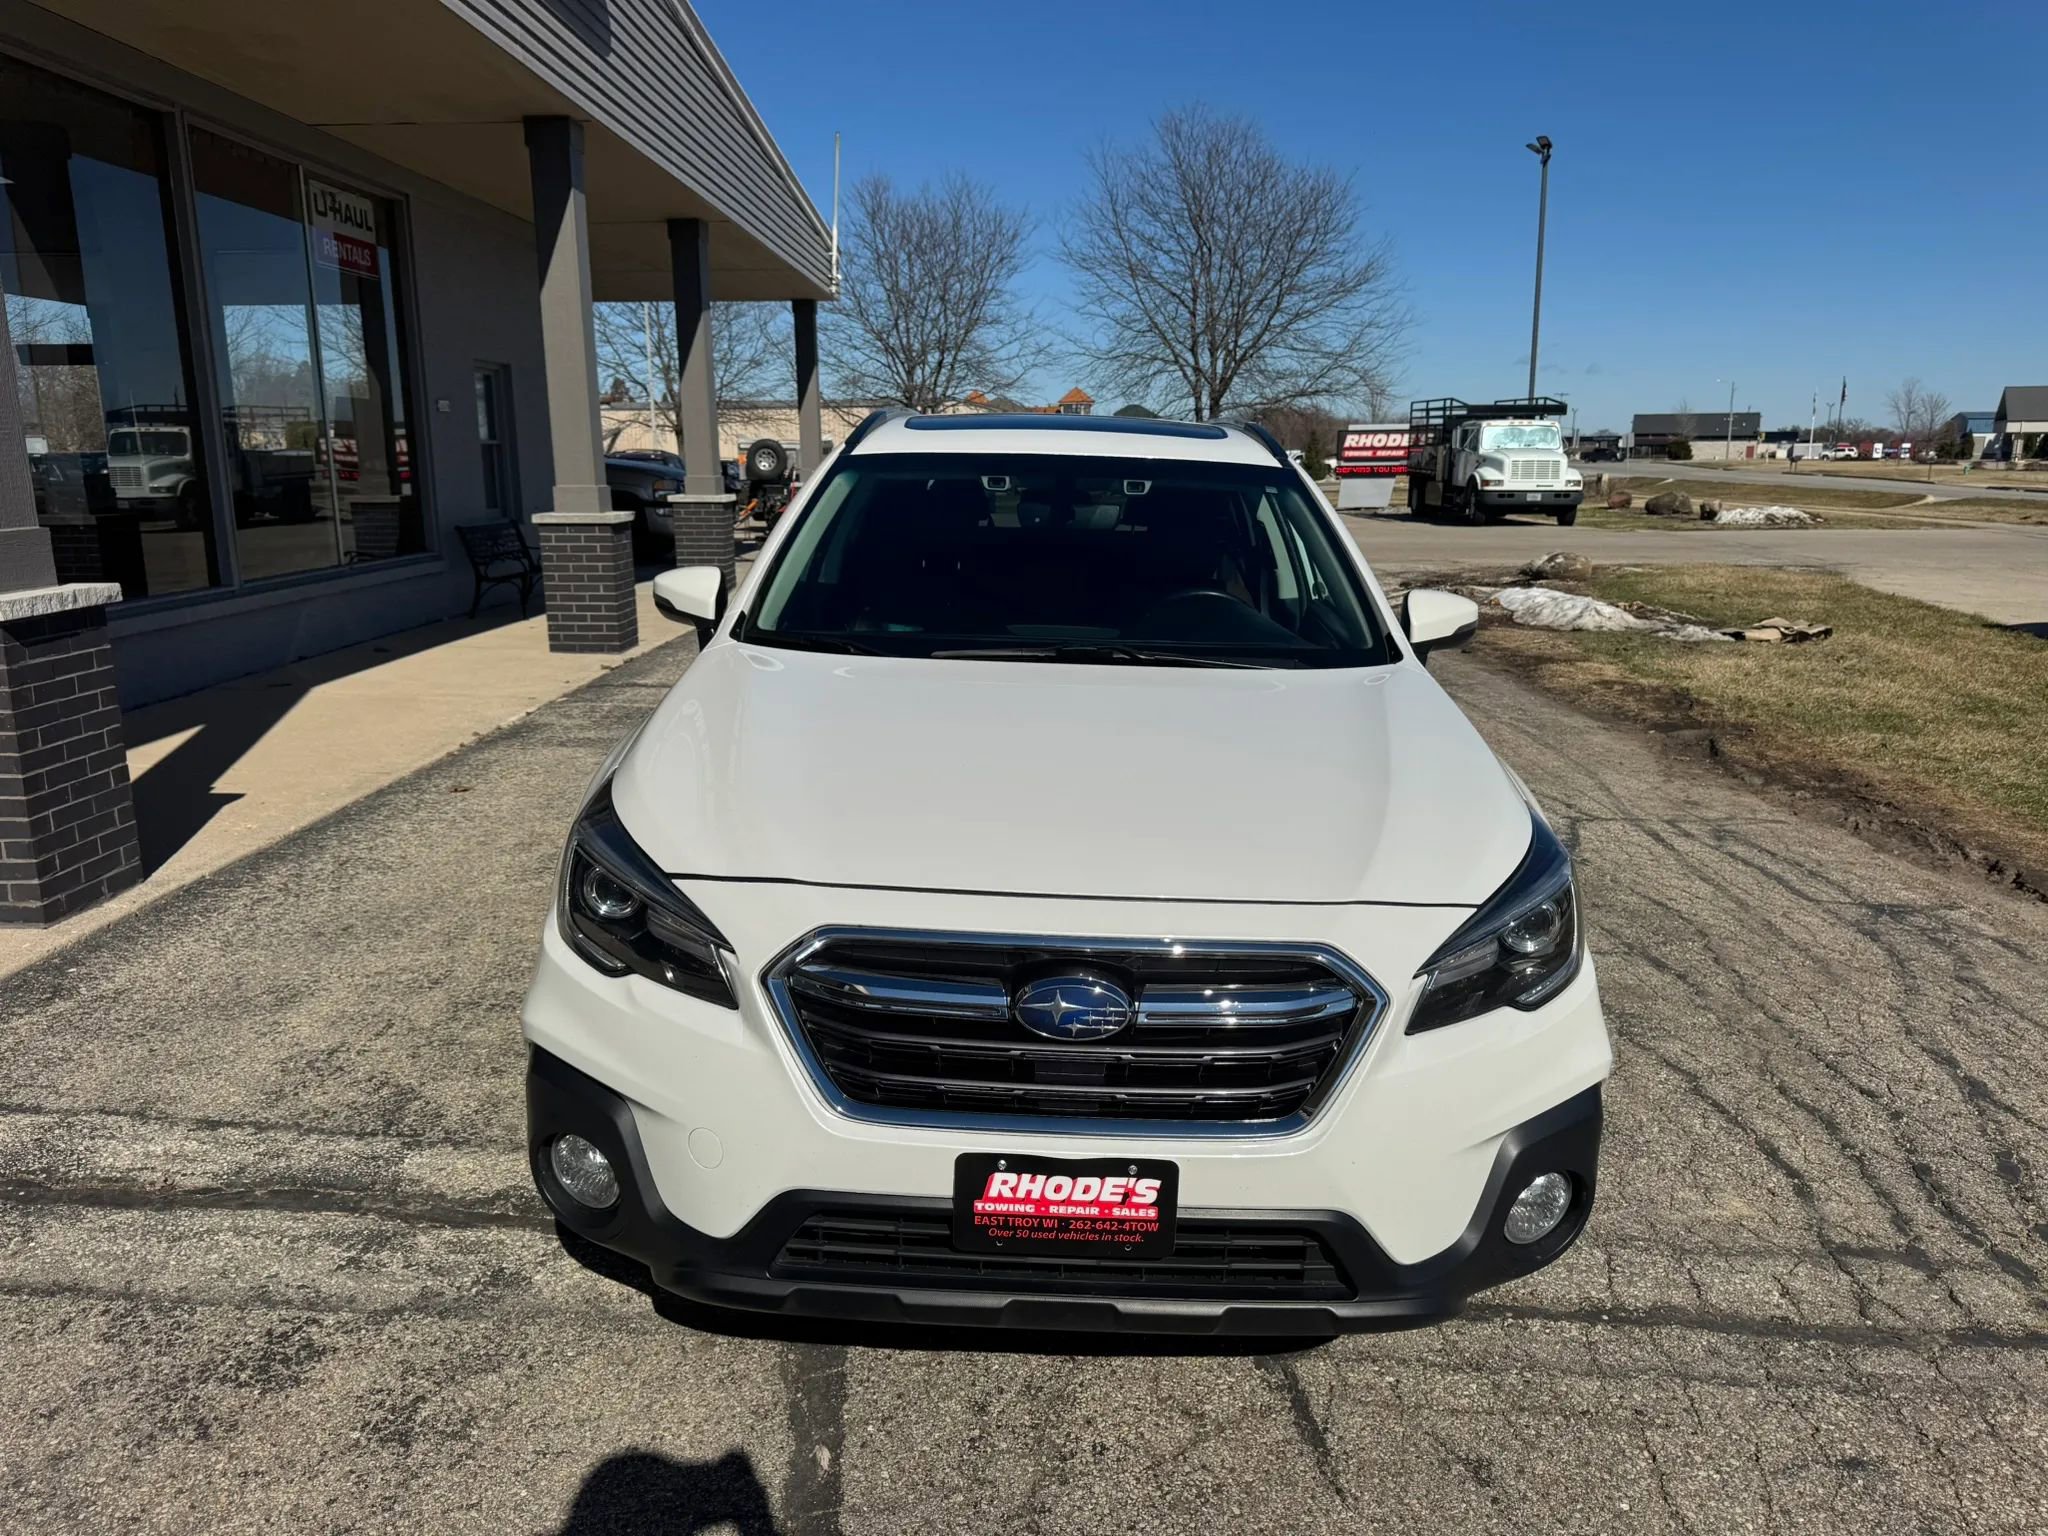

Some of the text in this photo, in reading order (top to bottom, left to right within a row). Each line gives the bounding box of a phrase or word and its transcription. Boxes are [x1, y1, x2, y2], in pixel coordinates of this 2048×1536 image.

[323, 238, 372, 266] RENTALS
[985, 1172, 1161, 1204] RHODE'S
[975, 1202, 1156, 1217] TOWING REPAIR SALES
[974, 1215, 1159, 1232] EAST TROY WI 262-642-4TOW
[988, 1227, 1144, 1243] Over 50 used vehicles in stock.
